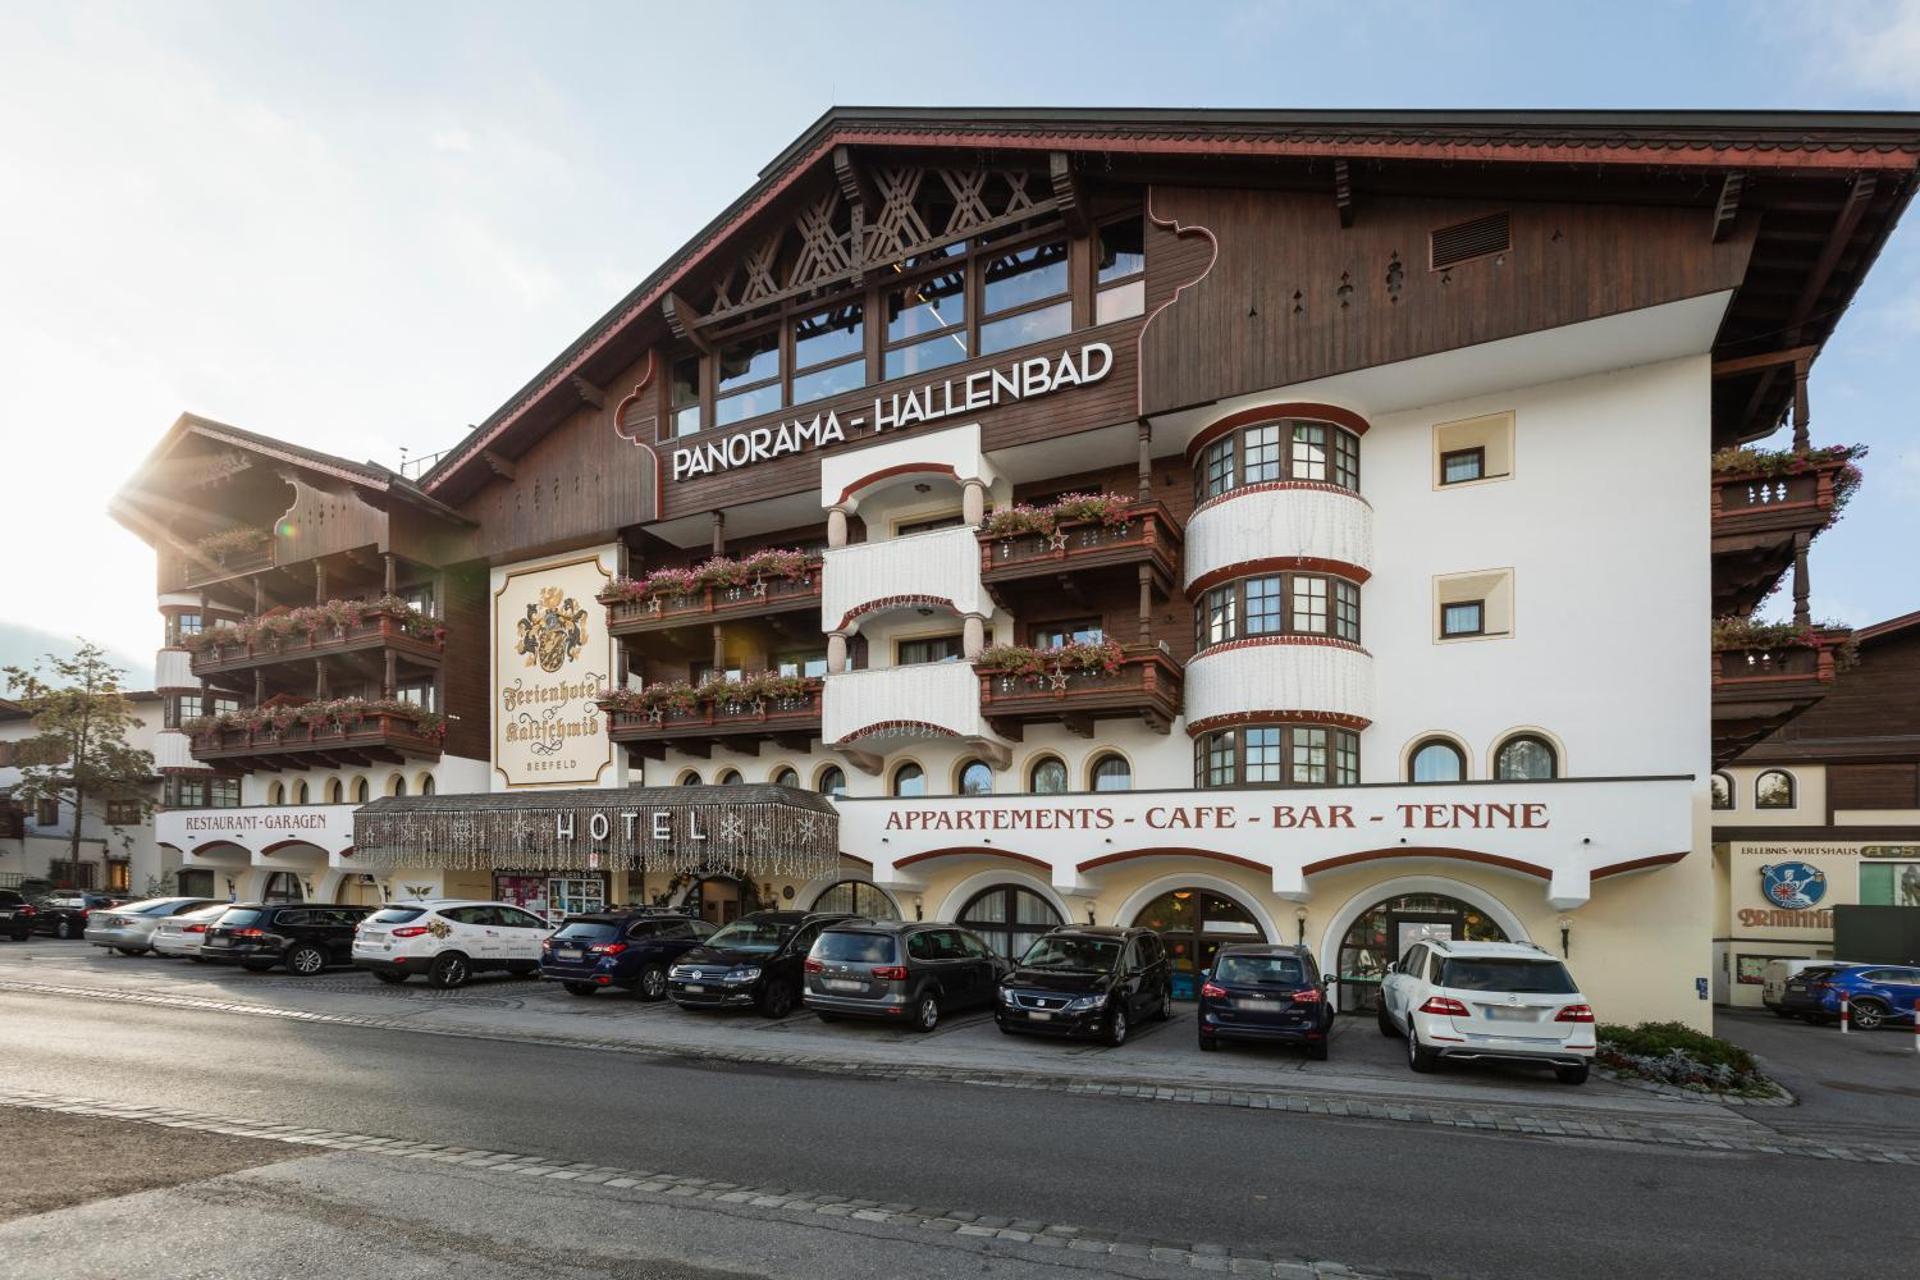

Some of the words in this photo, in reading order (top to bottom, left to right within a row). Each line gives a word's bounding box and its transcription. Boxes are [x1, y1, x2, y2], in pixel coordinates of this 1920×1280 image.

[672, 409, 845, 481] PANORAMA
[875, 341, 1114, 433] HALLENBAD
[502, 673, 606, 712] Ferienhotel
[526, 760, 577, 772] SEEFELD
[557, 811, 706, 840] HOTEL
[885, 807, 1114, 831] APPARTEMENTS
[1145, 806, 1236, 829] CAFE
[1272, 805, 1356, 828] BAR
[1396, 803, 1550, 828] TENNE
